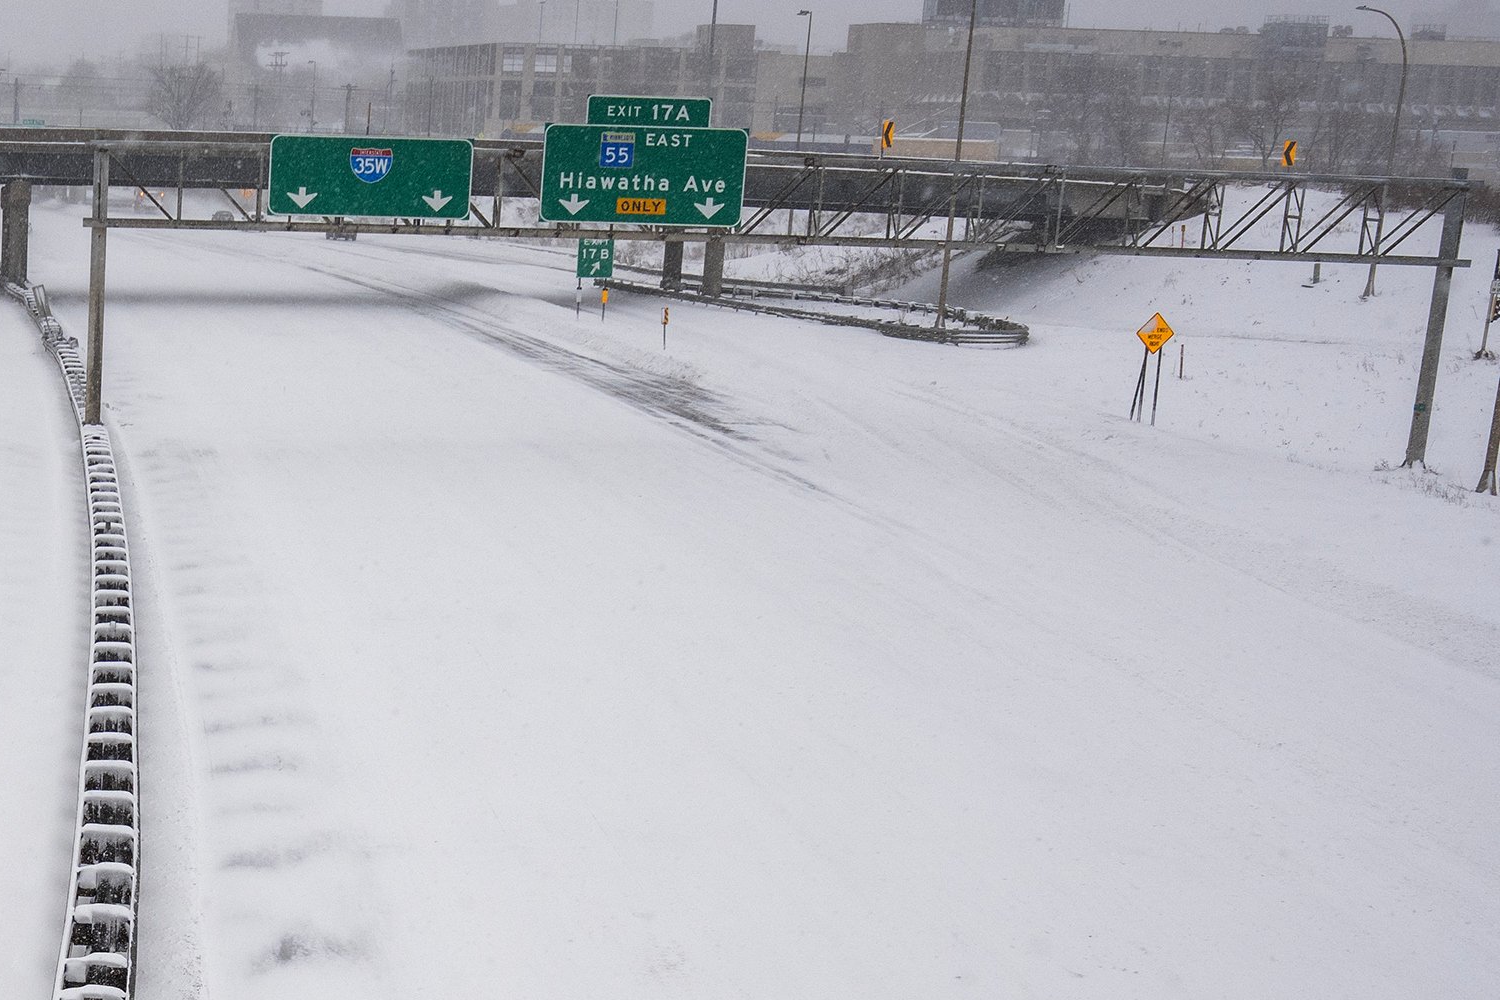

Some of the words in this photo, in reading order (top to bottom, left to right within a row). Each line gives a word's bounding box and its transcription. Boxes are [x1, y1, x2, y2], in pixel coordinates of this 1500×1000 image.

[607, 105, 642, 117] EXIT
[652, 104, 690, 121] 17A
[645, 133, 693, 147] EAST
[605, 146, 629, 163] 55
[354, 157, 388, 174] 35W
[559, 171, 670, 191] Hiawatha
[683, 175, 726, 193] Ave
[621, 200, 662, 212] ONLY
[583, 238, 609, 246] EXIT
